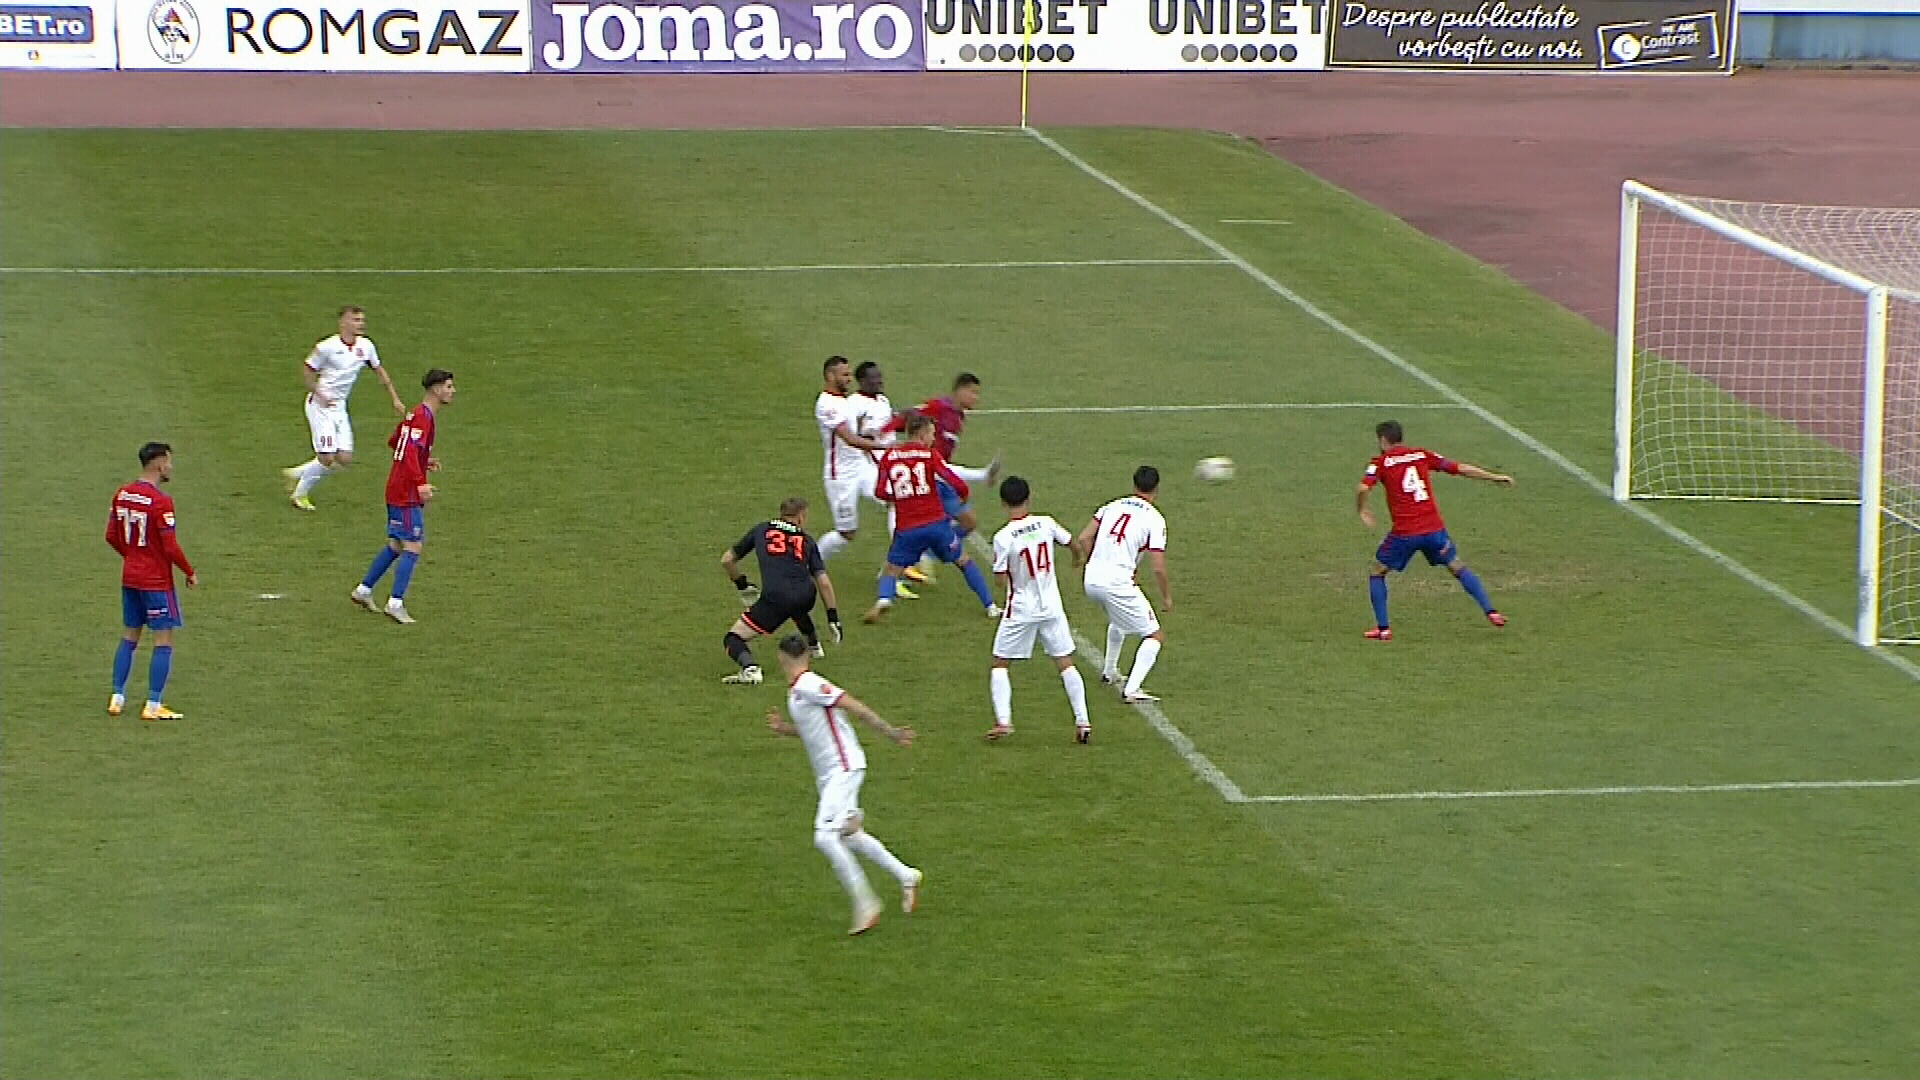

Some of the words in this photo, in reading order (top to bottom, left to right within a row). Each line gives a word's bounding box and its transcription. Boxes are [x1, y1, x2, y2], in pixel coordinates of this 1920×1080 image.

[227, 7, 523, 55] ROMGAZ
[926, 0, 1108, 34] UNIBET
[1149, 0, 1327, 35] UNIBET
[1341, 3, 1437, 37] Despre
[1437, 1, 1580, 37] publicitate
[542, 2, 914, 70] joma.ro
[1398, 31, 1496, 64] vorbești
[1500, 40, 1535, 58] cu
[1539, 39, 1584, 58] noi.
[1641, 31, 1701, 50] Contrast
[889, 462, 931, 498] 21
[1401, 466, 1430, 502] 4
[116, 506, 148, 547] 77
[765, 529, 805, 560] 31
[1109, 513, 1132, 545] 4
[1018, 541, 1051, 578] 14
